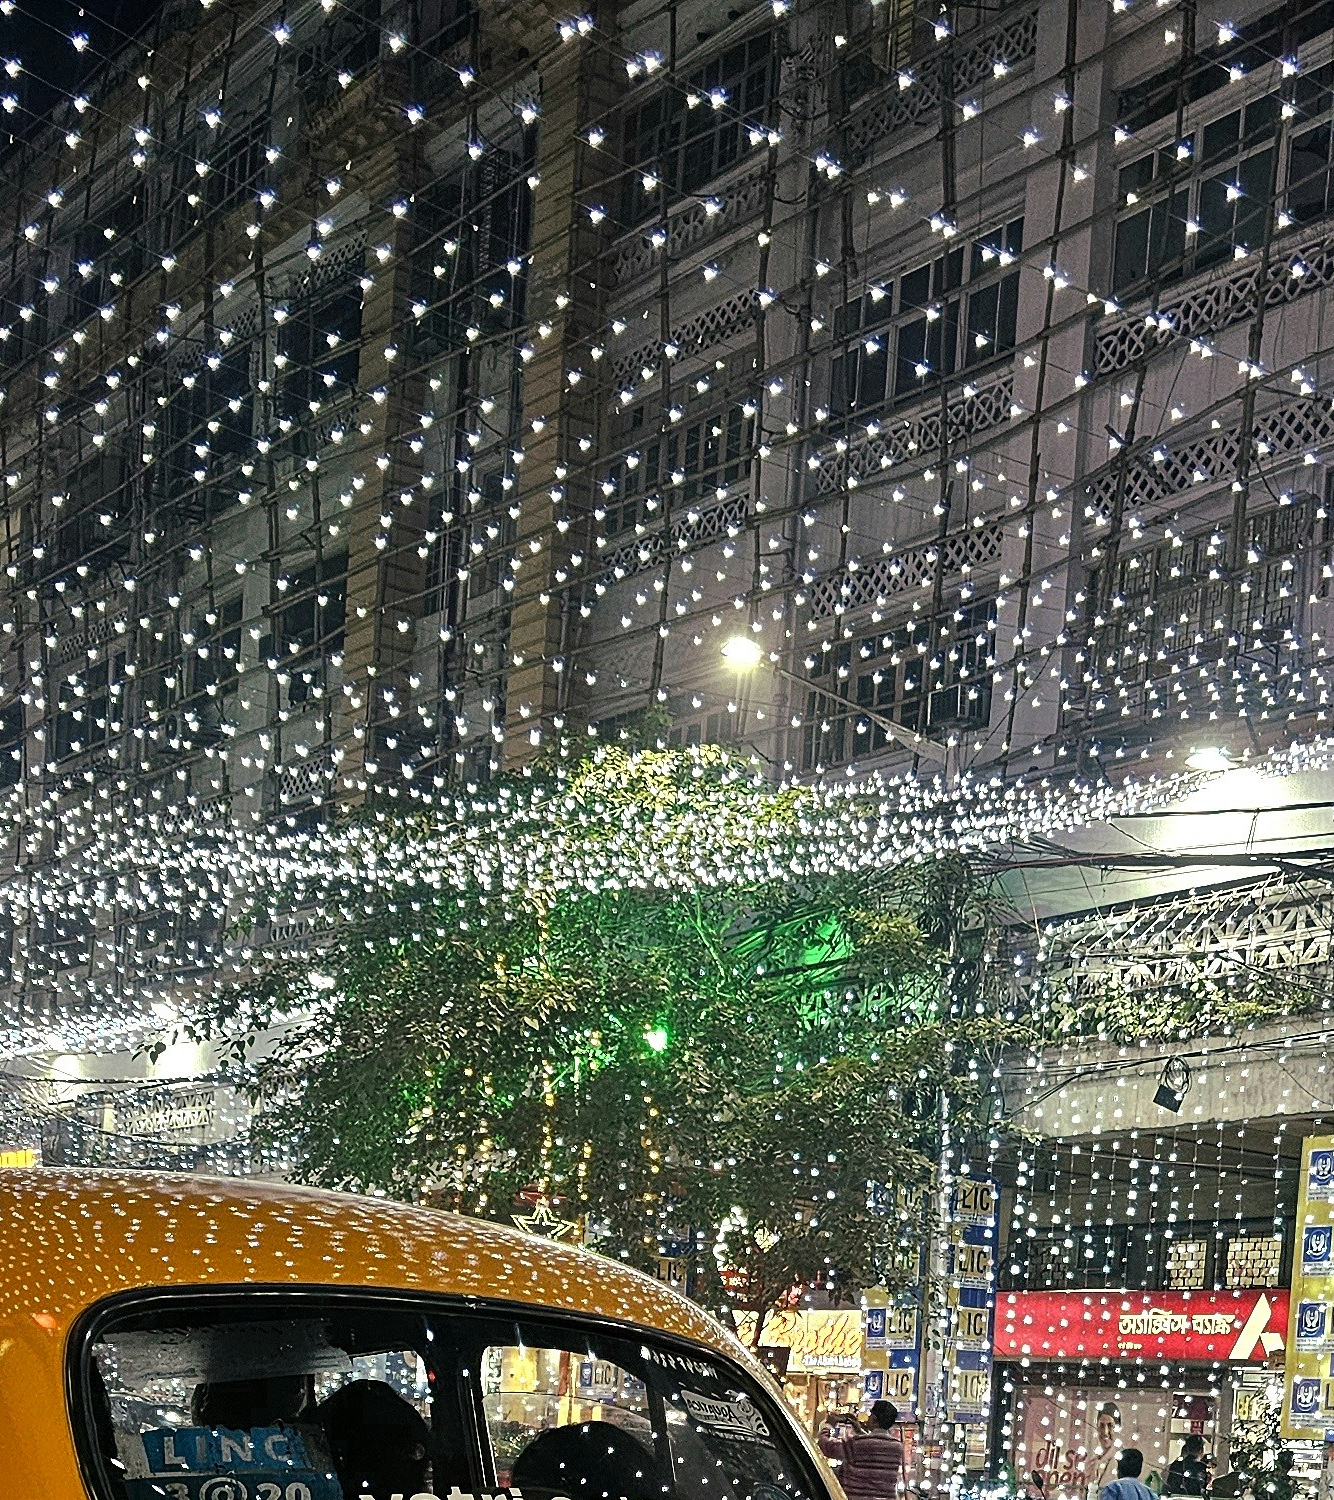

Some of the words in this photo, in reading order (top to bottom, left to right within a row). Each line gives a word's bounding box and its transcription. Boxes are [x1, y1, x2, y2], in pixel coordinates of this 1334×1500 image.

[962, 1187, 990, 1211] LIC
[888, 1306, 912, 1333] LIC
[884, 1372, 909, 1396] LIC
[1035, 1440, 1060, 1469] dil
[1063, 1449, 1088, 1471] se
